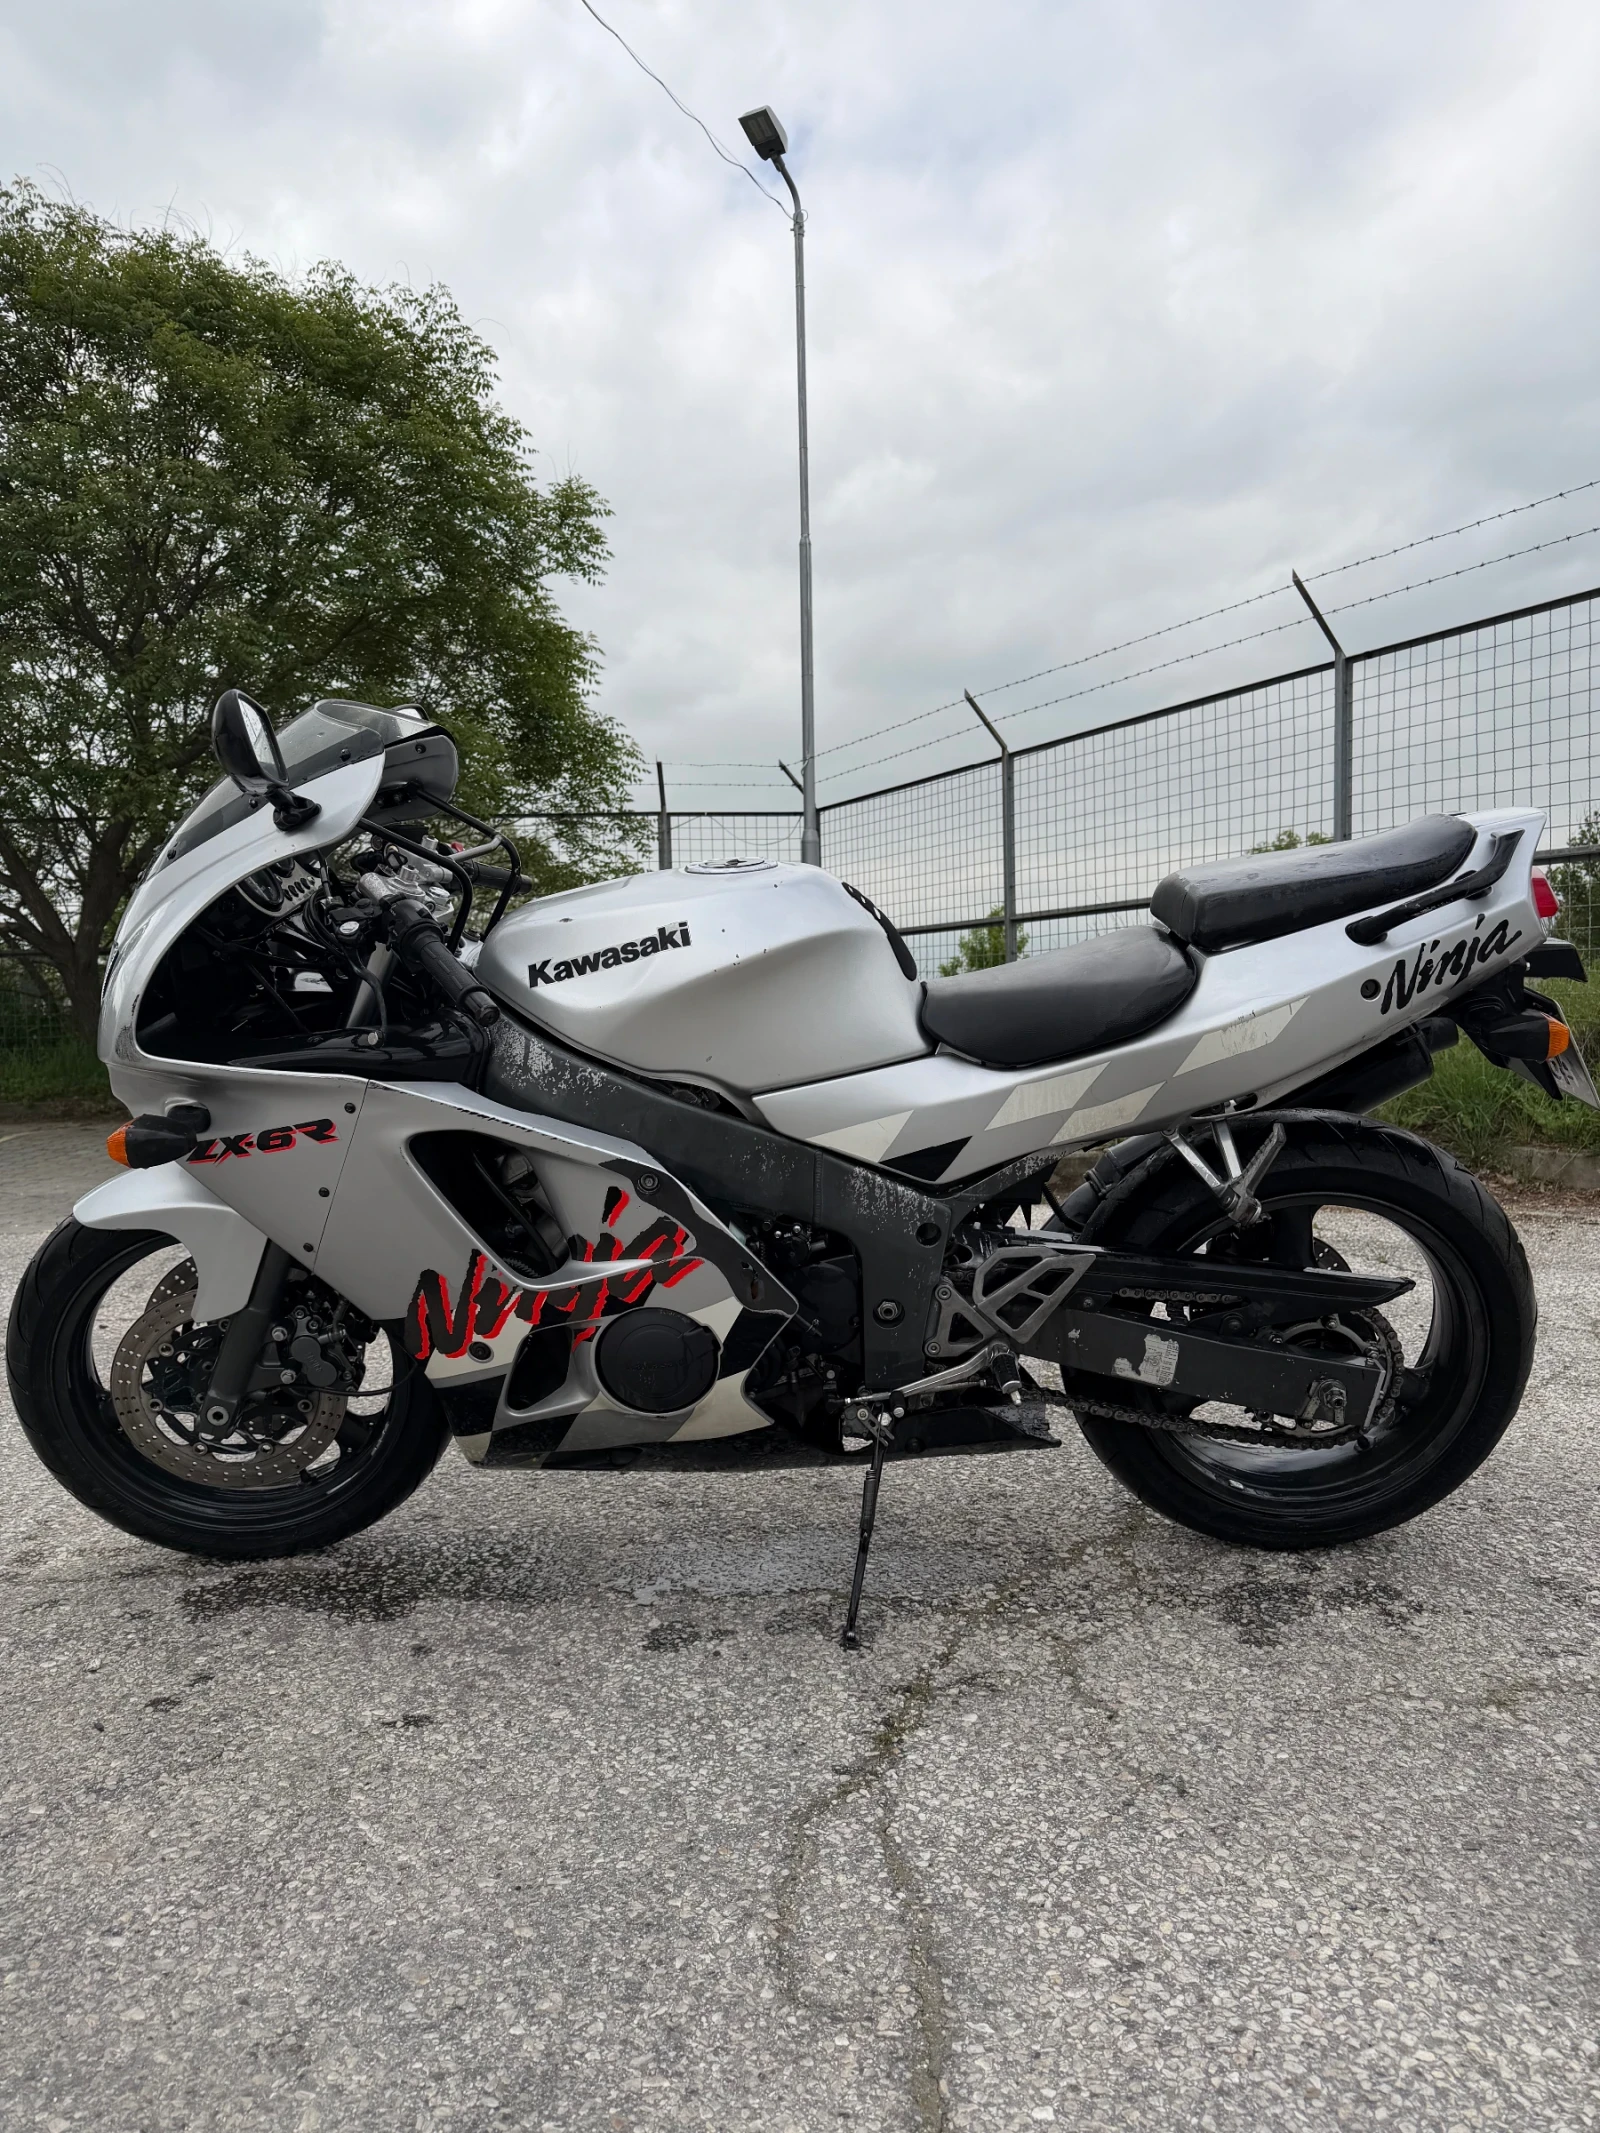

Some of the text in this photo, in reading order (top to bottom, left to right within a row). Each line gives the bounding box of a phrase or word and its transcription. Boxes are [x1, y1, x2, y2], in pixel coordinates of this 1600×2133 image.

[528, 921, 691, 989] Kawasaki
[1380, 913, 1522, 1015] Ninja
[186, 1118, 339, 1166] ZX-6R
